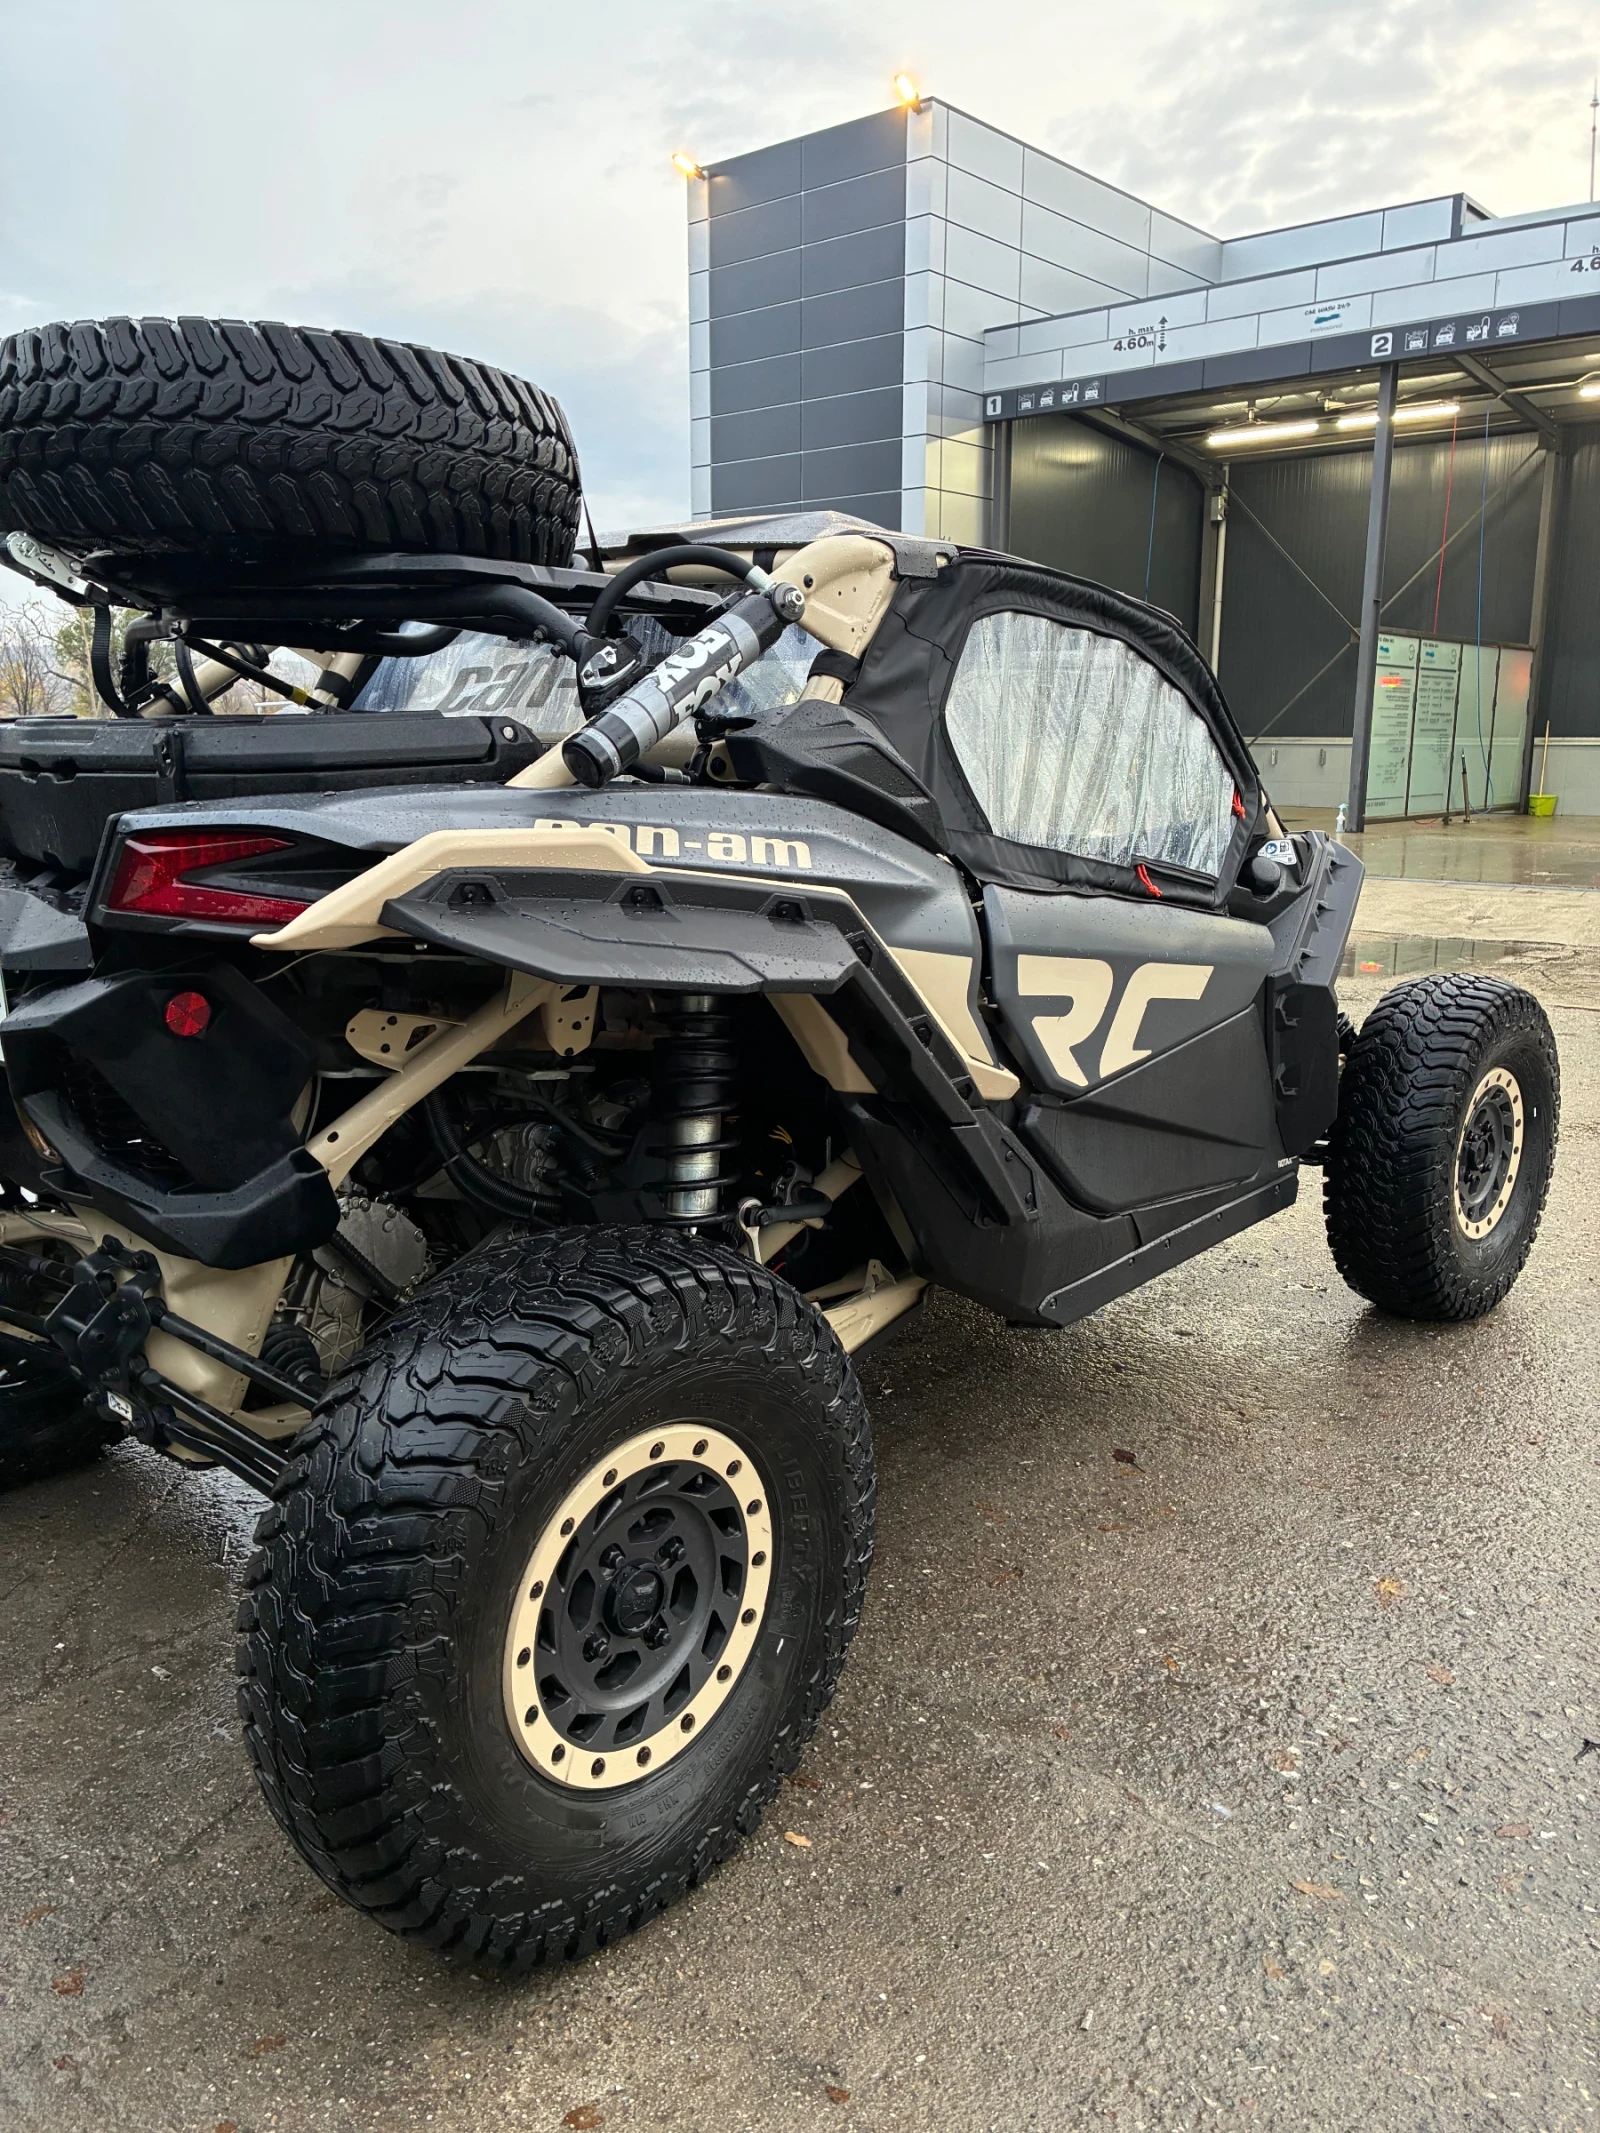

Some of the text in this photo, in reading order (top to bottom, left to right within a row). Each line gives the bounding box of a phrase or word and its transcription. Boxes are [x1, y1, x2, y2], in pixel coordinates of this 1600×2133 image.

[1138, 325, 1154, 334] max
[1374, 336, 1390, 354] 2
[990, 398, 998, 413] 1
[435, 655, 581, 713] can-
[534, 818, 813, 869] n-am
